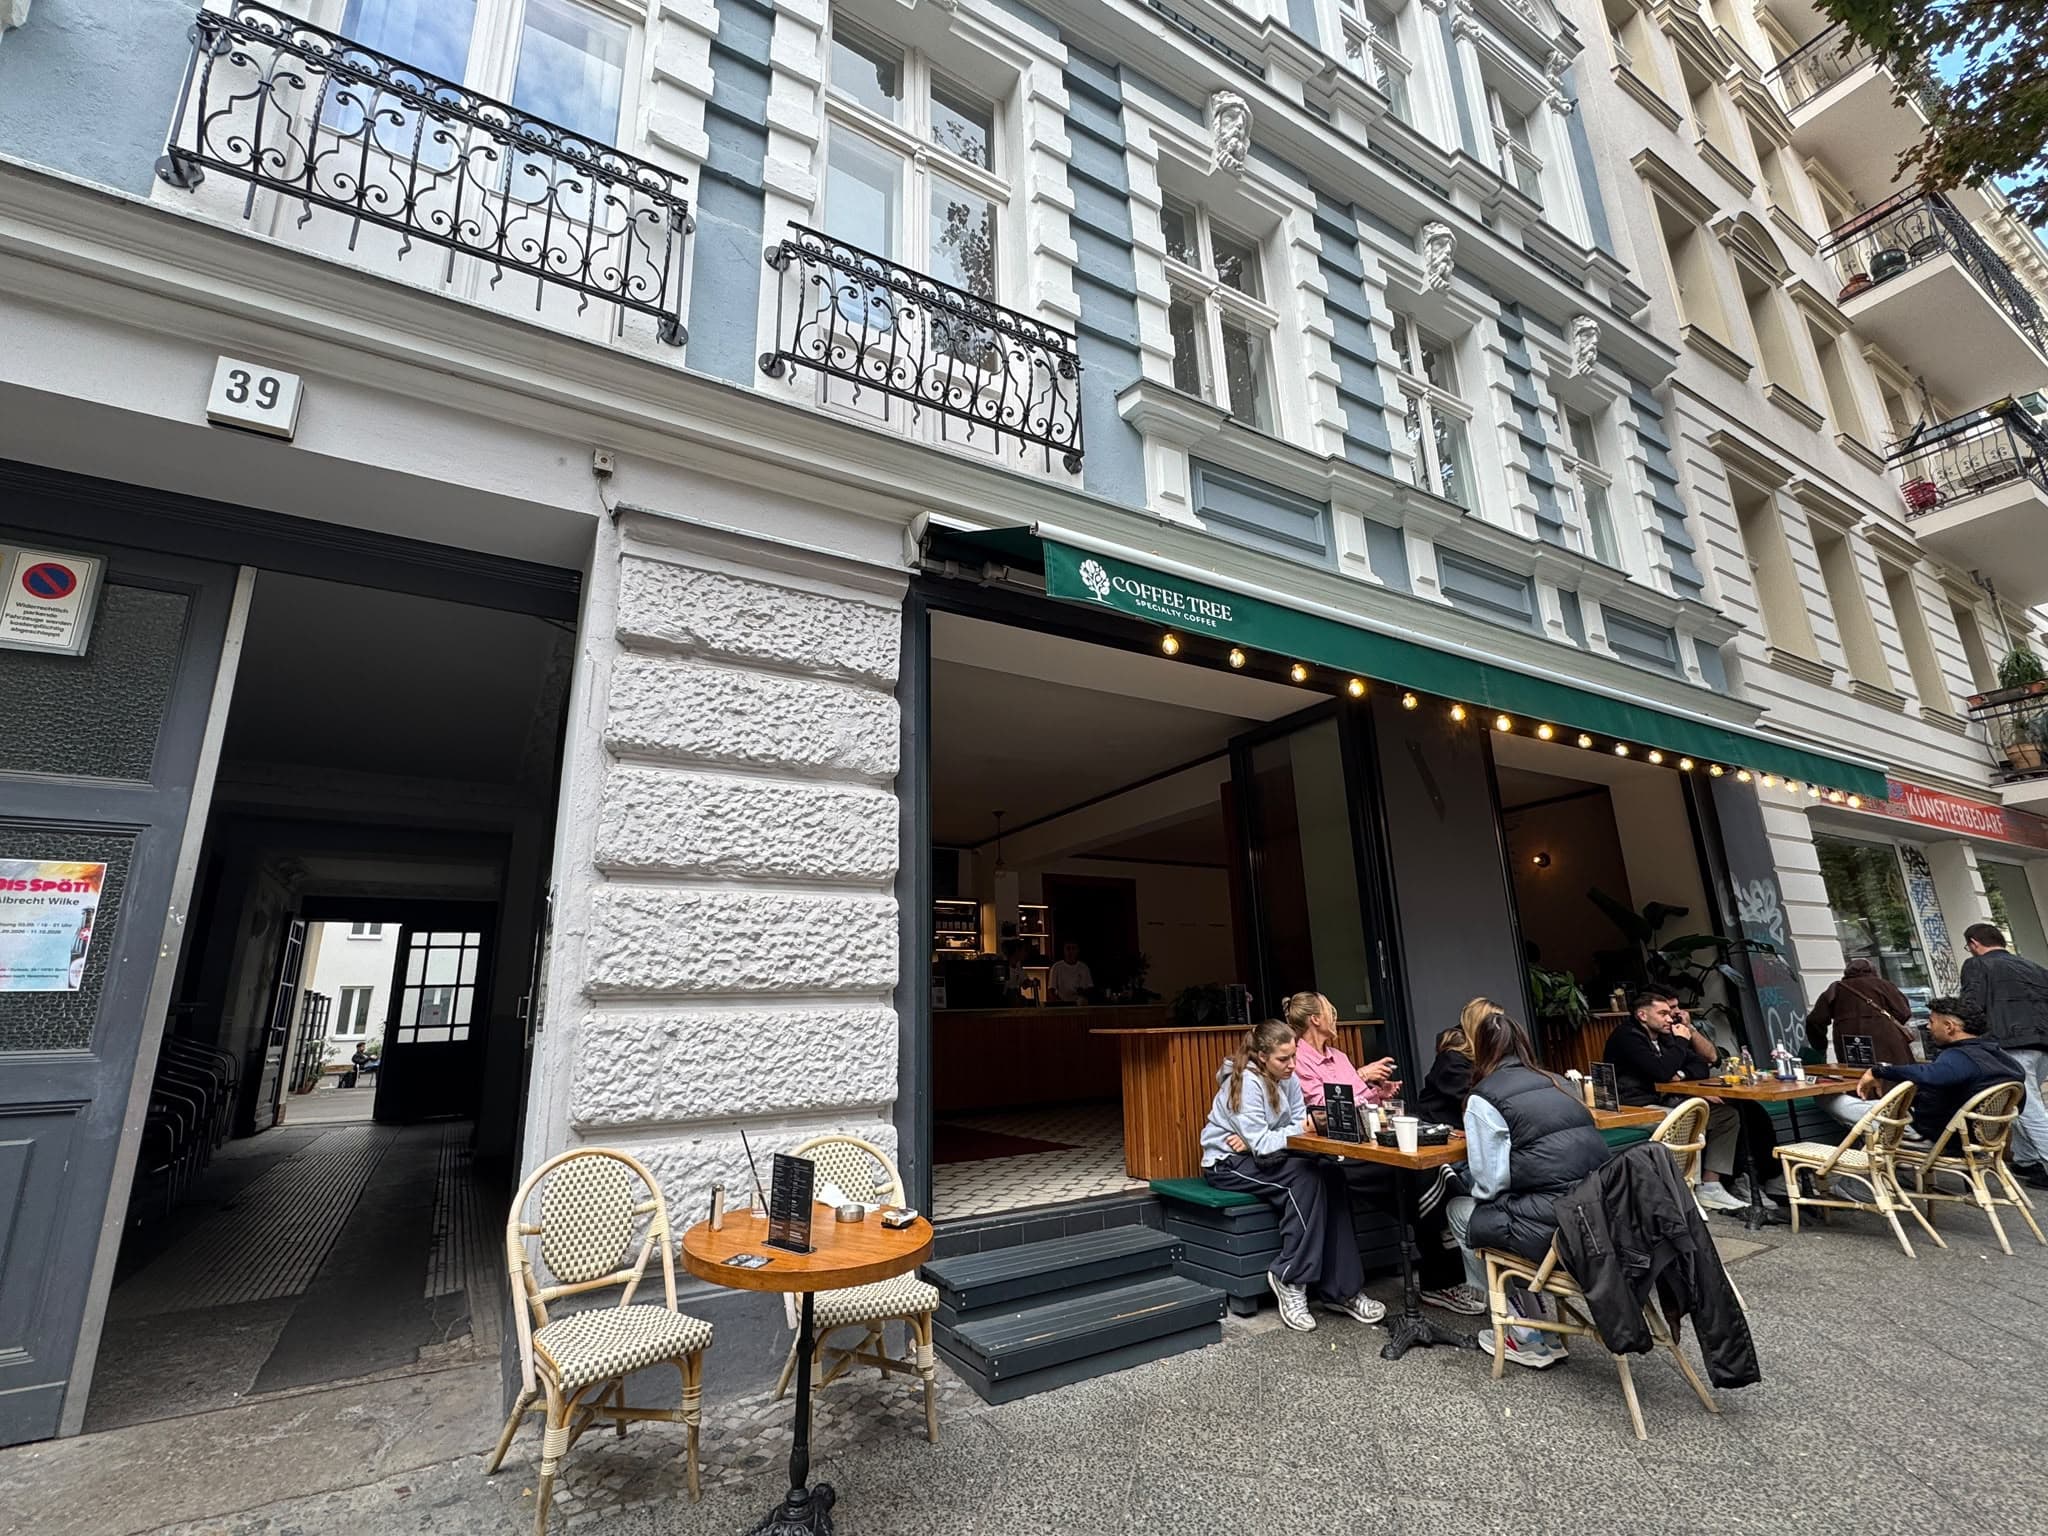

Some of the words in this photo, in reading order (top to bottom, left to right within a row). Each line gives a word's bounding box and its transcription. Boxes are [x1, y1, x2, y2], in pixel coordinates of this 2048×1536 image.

[226, 369, 280, 409] 39
[15, 601, 69, 614] Widerrechtlich
[1112, 576, 1185, 610] COFFEE
[1186, 596, 1233, 622] TREE
[5, 612, 44, 623] Fahrzeuge
[23, 609, 58, 618] parkende
[1135, 598, 1182, 618] SPECIALTY
[1183, 613, 1217, 628] COFFEE
[1905, 786, 2004, 835] KÜNSTLERBEDARF
[48, 897, 80, 906] Wilke
